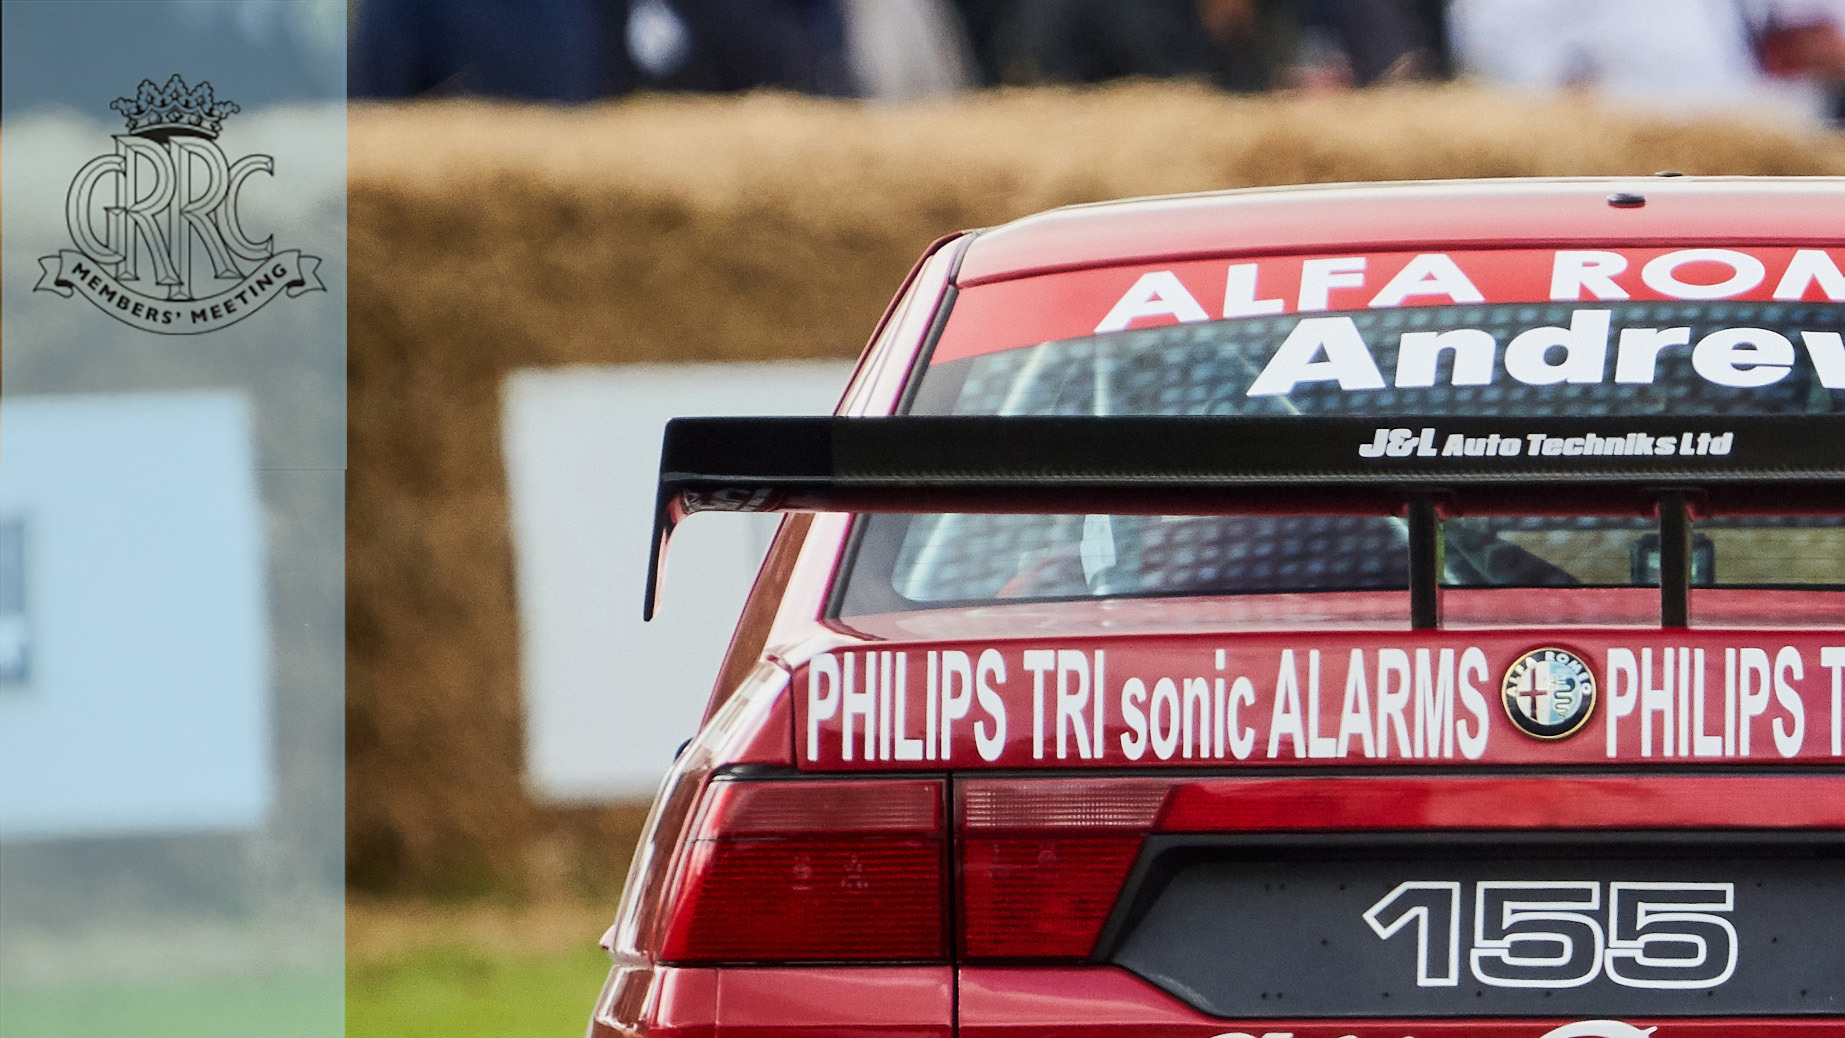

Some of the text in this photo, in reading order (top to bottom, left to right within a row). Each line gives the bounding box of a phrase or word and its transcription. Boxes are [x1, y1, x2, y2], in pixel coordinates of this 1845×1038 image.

[1094, 252, 1485, 333] ALFA
[1358, 427, 1734, 458] J&L Auto Techniks Ltd
[807, 646, 1490, 762] PHILIPS TRI sonic ALARMS
[1544, 651, 1592, 695] ROMEO
[1605, 645, 1806, 759] PHILIPS
[1362, 880, 1739, 990] 155
